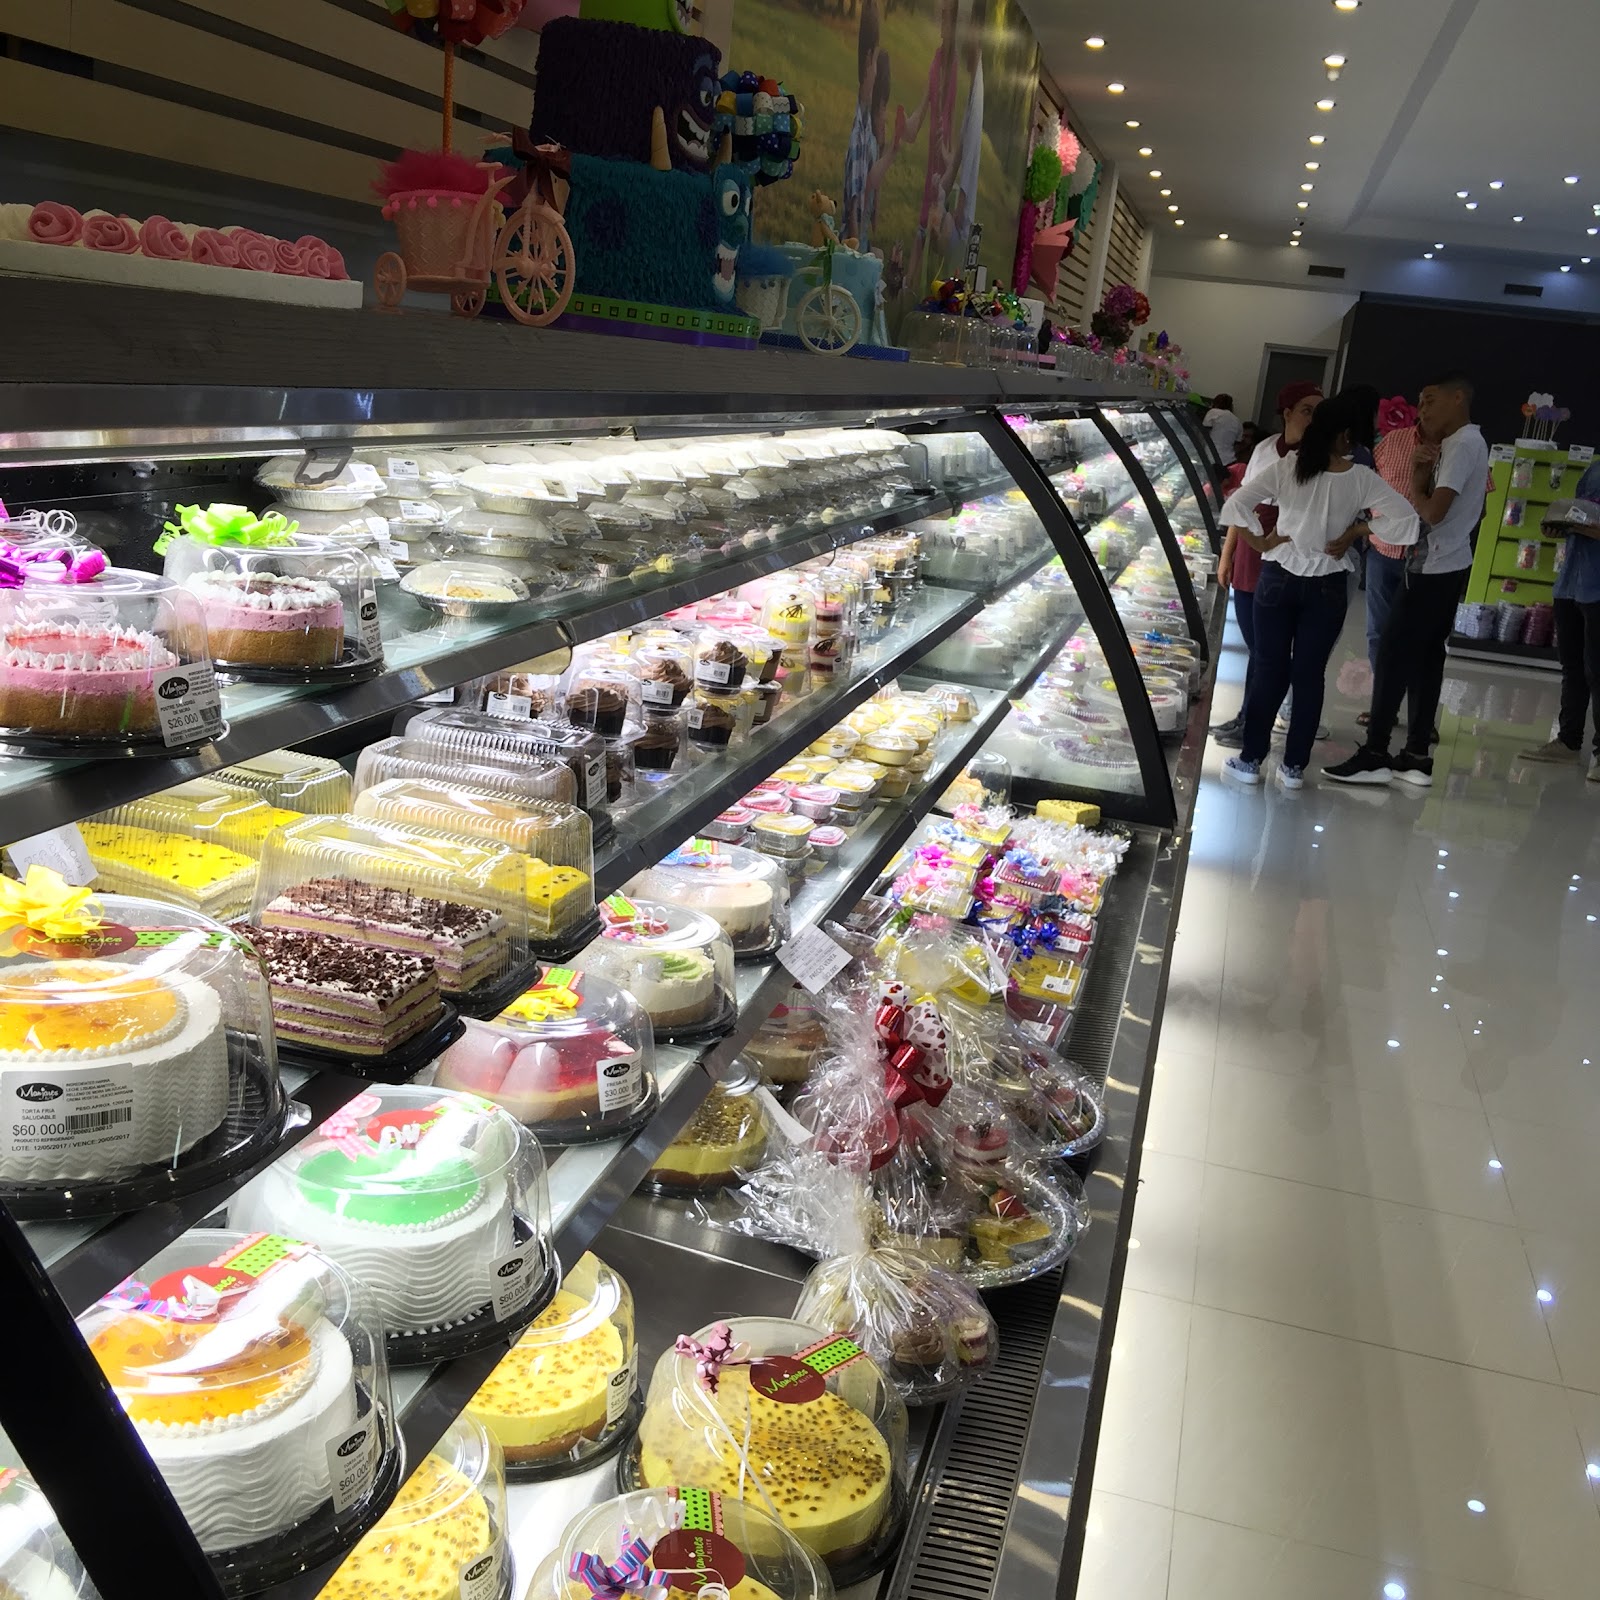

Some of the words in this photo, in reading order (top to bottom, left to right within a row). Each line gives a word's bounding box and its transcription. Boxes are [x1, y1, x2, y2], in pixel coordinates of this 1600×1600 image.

[168, 713, 198, 729] $26.000
[824, 954, 837, 966] VENTA
[21, 1085, 58, 1100] Manjares
[605, 1086, 629, 1097] $30.000
[12, 1124, 65, 1136] $60.000
[760, 1369, 808, 1394] Manjares
[799, 1374, 813, 1383] ELITE
[686, 1537, 712, 1586] Manjares
